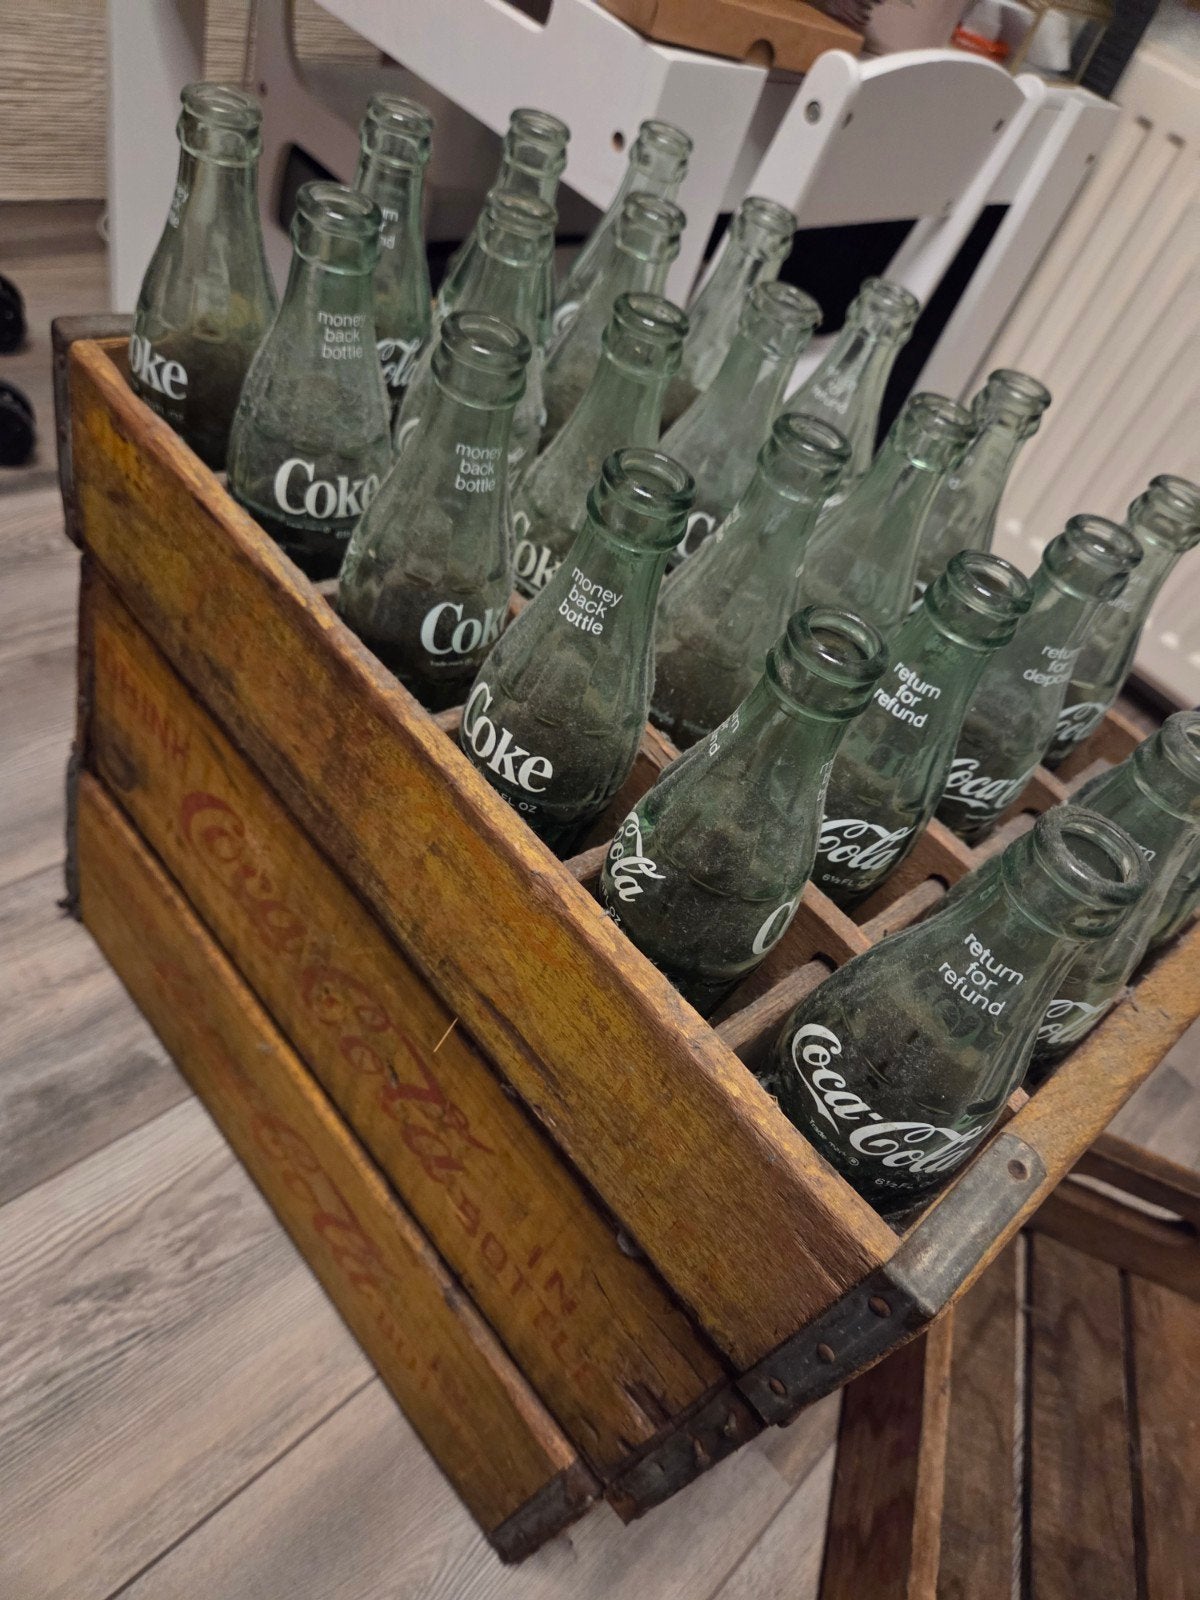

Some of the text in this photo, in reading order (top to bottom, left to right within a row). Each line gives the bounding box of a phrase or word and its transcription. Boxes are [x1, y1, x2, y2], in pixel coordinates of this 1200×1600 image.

[322, 342, 363, 360] bottle
[324, 327, 360, 343] back
[128, 333, 189, 400] oke
[456, 442, 501, 462] money
[460, 459, 495, 476] back
[455, 474, 496, 494] bottle
[567, 584, 608, 619] back
[571, 567, 623, 608] money
[420, 601, 506, 655] Cok
[558, 598, 604, 636] bottle
[893, 661, 941, 700] return
[895, 682, 922, 708] for
[873, 687, 928, 729] refund
[463, 681, 554, 793] Coke
[518, 801, 538, 814] OZ
[964, 932, 1024, 986] return
[965, 961, 999, 991] for
[938, 962, 1007, 1016] refund
[791, 1023, 993, 1174] Coca-Cola
